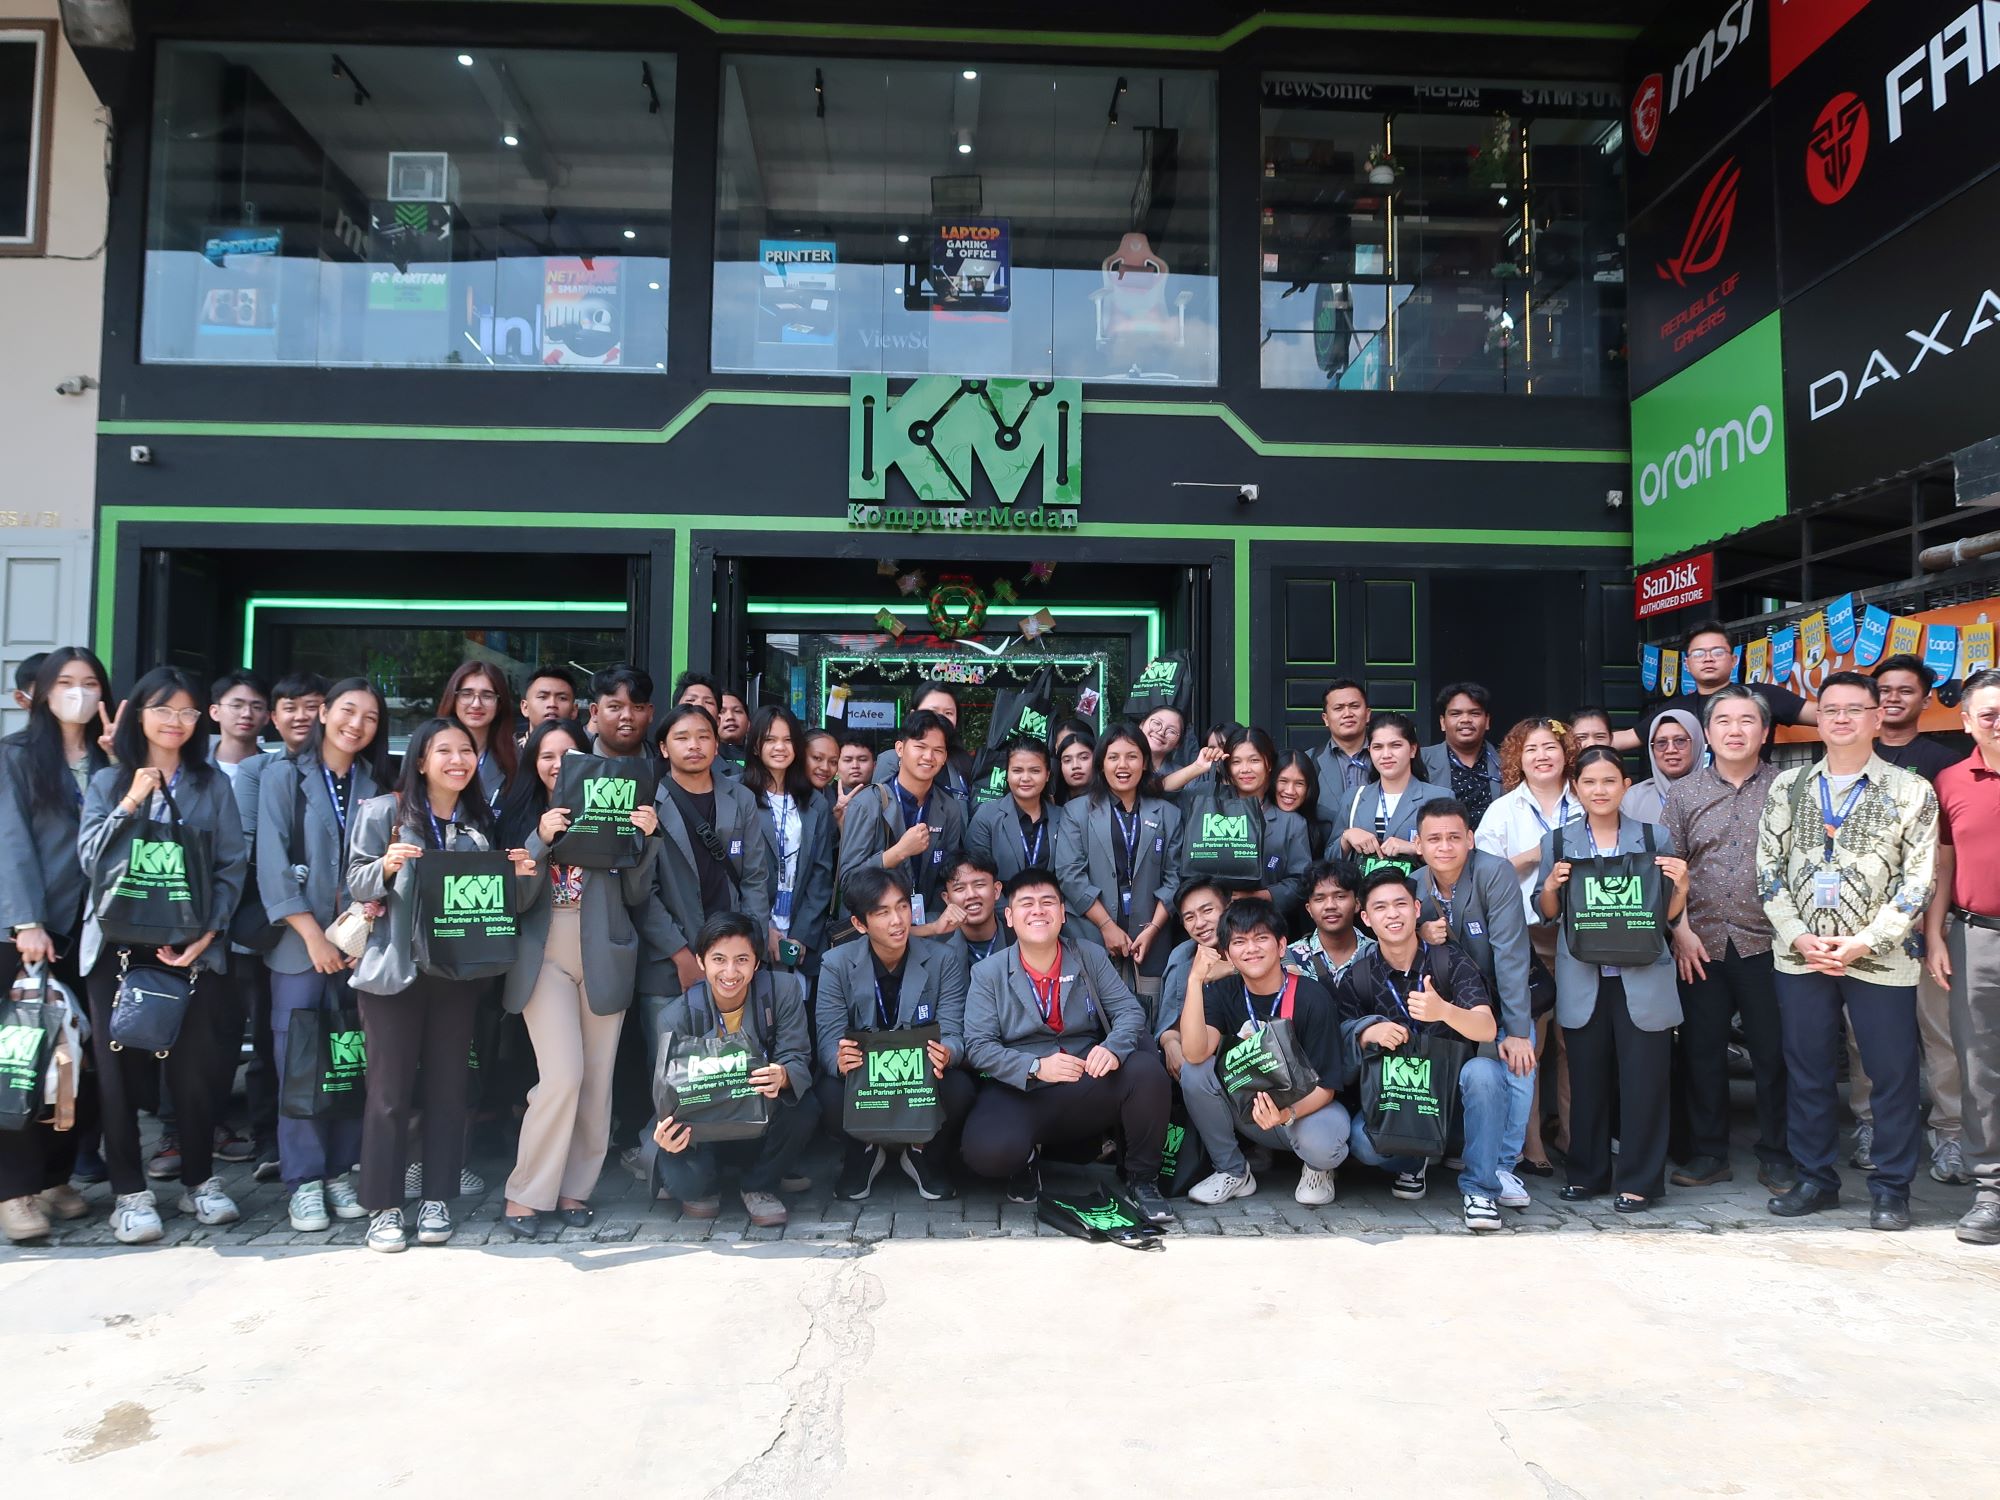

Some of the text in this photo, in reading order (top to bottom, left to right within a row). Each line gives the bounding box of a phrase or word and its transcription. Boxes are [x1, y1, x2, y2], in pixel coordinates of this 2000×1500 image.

[1668, 0, 1754, 115] msi
[941, 226, 1000, 240] LAPTOP
[947, 240, 988, 249] GAMING
[765, 249, 831, 262] PRINTER
[959, 249, 997, 258] OFFICE
[1659, 272, 1740, 340] REPUBLIC OF
[1672, 306, 1727, 353] GAMERS
[849, 376, 1081, 503] KM
[1639, 404, 1774, 507] oraimo
[848, 503, 1080, 531] KomputerMedan
[1643, 563, 1698, 600] SanDisk
[1639, 588, 1704, 616] AUTHORIZED STORE
[1830, 607, 1851, 625] tapo
[1865, 618, 1885, 636] tapo
[1895, 626, 1917, 639] AMAN
[1967, 632, 1990, 643] AMAN
[1929, 638, 1955, 655] tapo
[990, 766, 1008, 788] K
[583, 777, 636, 809] KM
[584, 814, 606, 822] Partner
[1202, 813, 1248, 838] KM
[130, 838, 185, 874] KM
[444, 875, 504, 909] KM
[1585, 876, 1643, 904] KM
[481, 915, 513, 923] Tehnology
[687, 1050, 747, 1082] KM
[868, 1047, 924, 1081] KM
[1382, 1056, 1431, 1089] KM
[676, 1085, 692, 1093] Best
[692, 1082, 717, 1091] Partner
[904, 1086, 934, 1094] Tehnology
[1386, 1092, 1406, 1100] Partner
